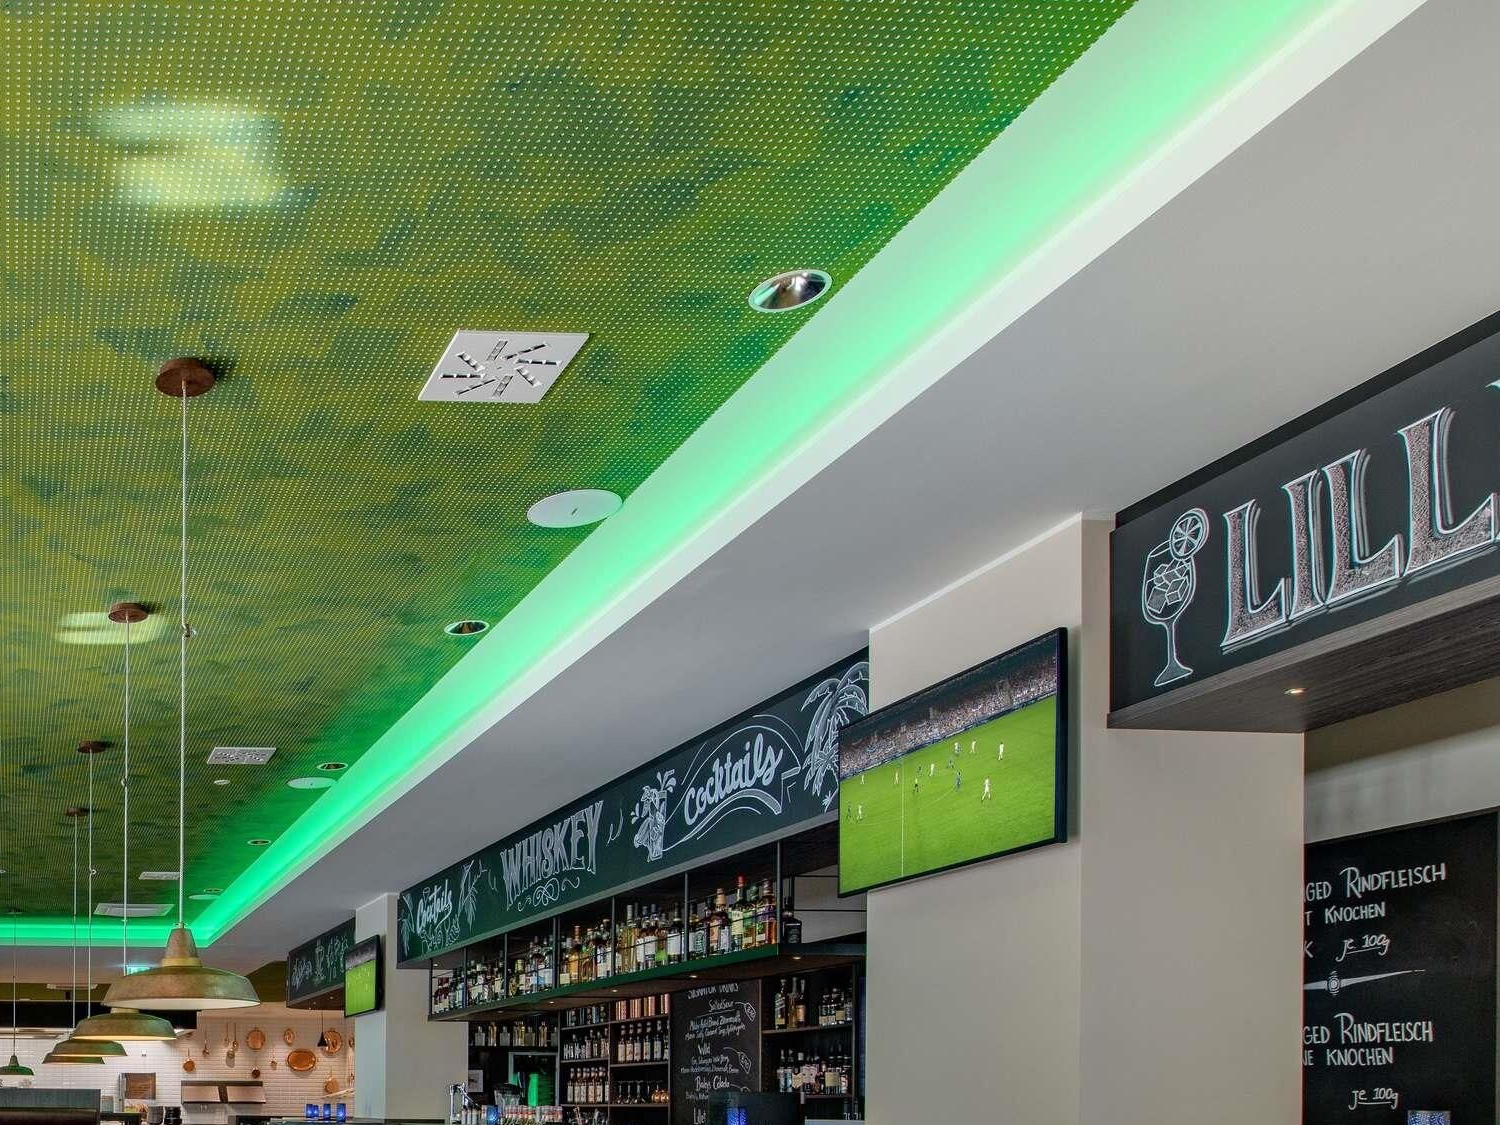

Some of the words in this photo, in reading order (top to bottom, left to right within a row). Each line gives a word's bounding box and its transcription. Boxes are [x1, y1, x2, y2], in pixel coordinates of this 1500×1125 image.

[1220, 382, 1500, 651] LILL
[684, 733, 783, 825] Cocktails
[500, 800, 604, 911] WHISKEY
[1303, 881, 1332, 902] GED
[1324, 902, 1386, 925] KNOCHEN
[1301, 1025, 1330, 1044] GED
[1327, 1047, 1394, 1066] KNOCHEN
